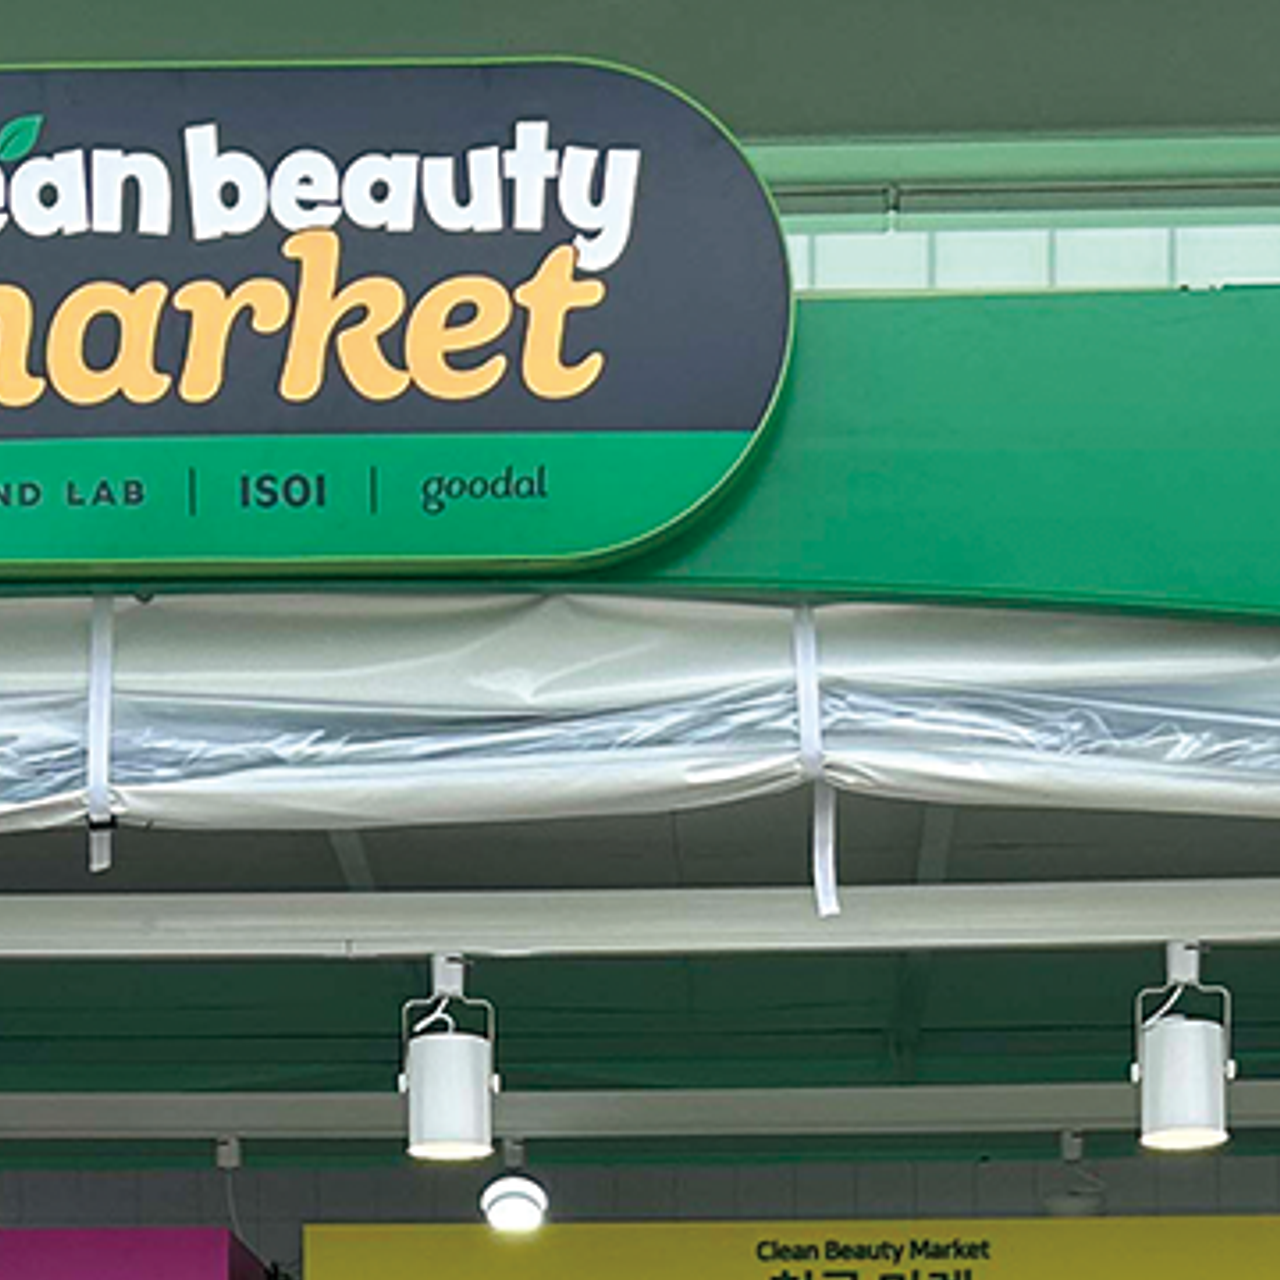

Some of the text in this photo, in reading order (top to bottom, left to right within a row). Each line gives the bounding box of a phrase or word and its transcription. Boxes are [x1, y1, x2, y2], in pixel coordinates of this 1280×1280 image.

[184, 119, 641, 272] beauty
[66, 478, 146, 507] LAB
[239, 473, 326, 508] ISOI
[422, 465, 549, 515] goodal
[756, 1238, 991, 1265] Clean Beauty Market
